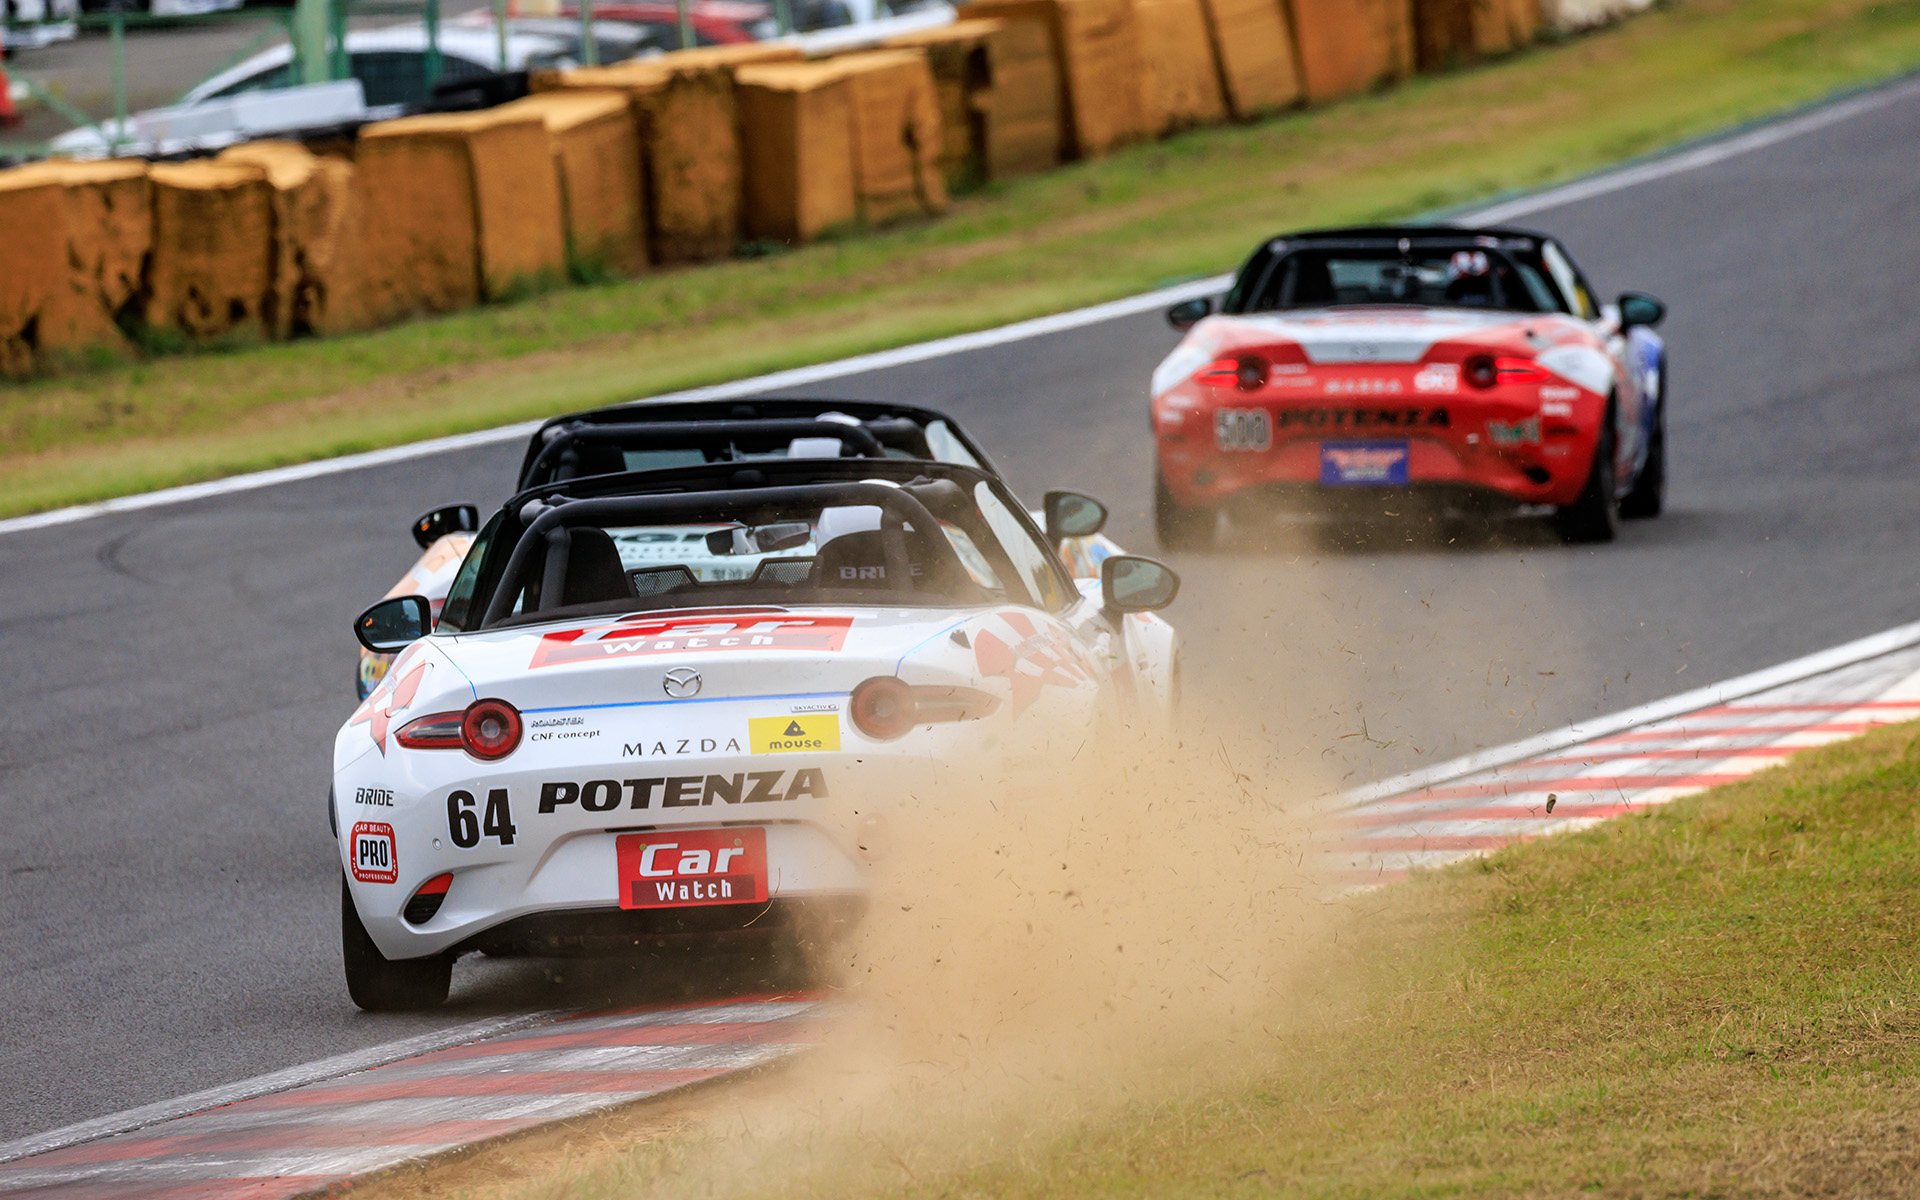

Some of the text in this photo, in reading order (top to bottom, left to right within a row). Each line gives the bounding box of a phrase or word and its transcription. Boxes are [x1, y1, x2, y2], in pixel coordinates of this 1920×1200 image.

[1214, 408, 1272, 451] 500
[838, 563, 924, 581] BRIE
[570, 620, 816, 646] Car
[602, 635, 774, 655] Watch
[531, 716, 585, 728] ROADSTER
[531, 730, 601, 742] CNF concept
[769, 737, 823, 751] mouse
[621, 737, 742, 758] MAZDA
[355, 788, 395, 807] BRIDE
[538, 768, 831, 815] POTENZA
[447, 788, 517, 848] 64
[354, 824, 391, 834] CAR BEAUTY
[359, 838, 389, 868] PRO
[639, 842, 745, 878] Car
[359, 873, 393, 881] PROFESSIONAL
[655, 879, 732, 901] Watch
